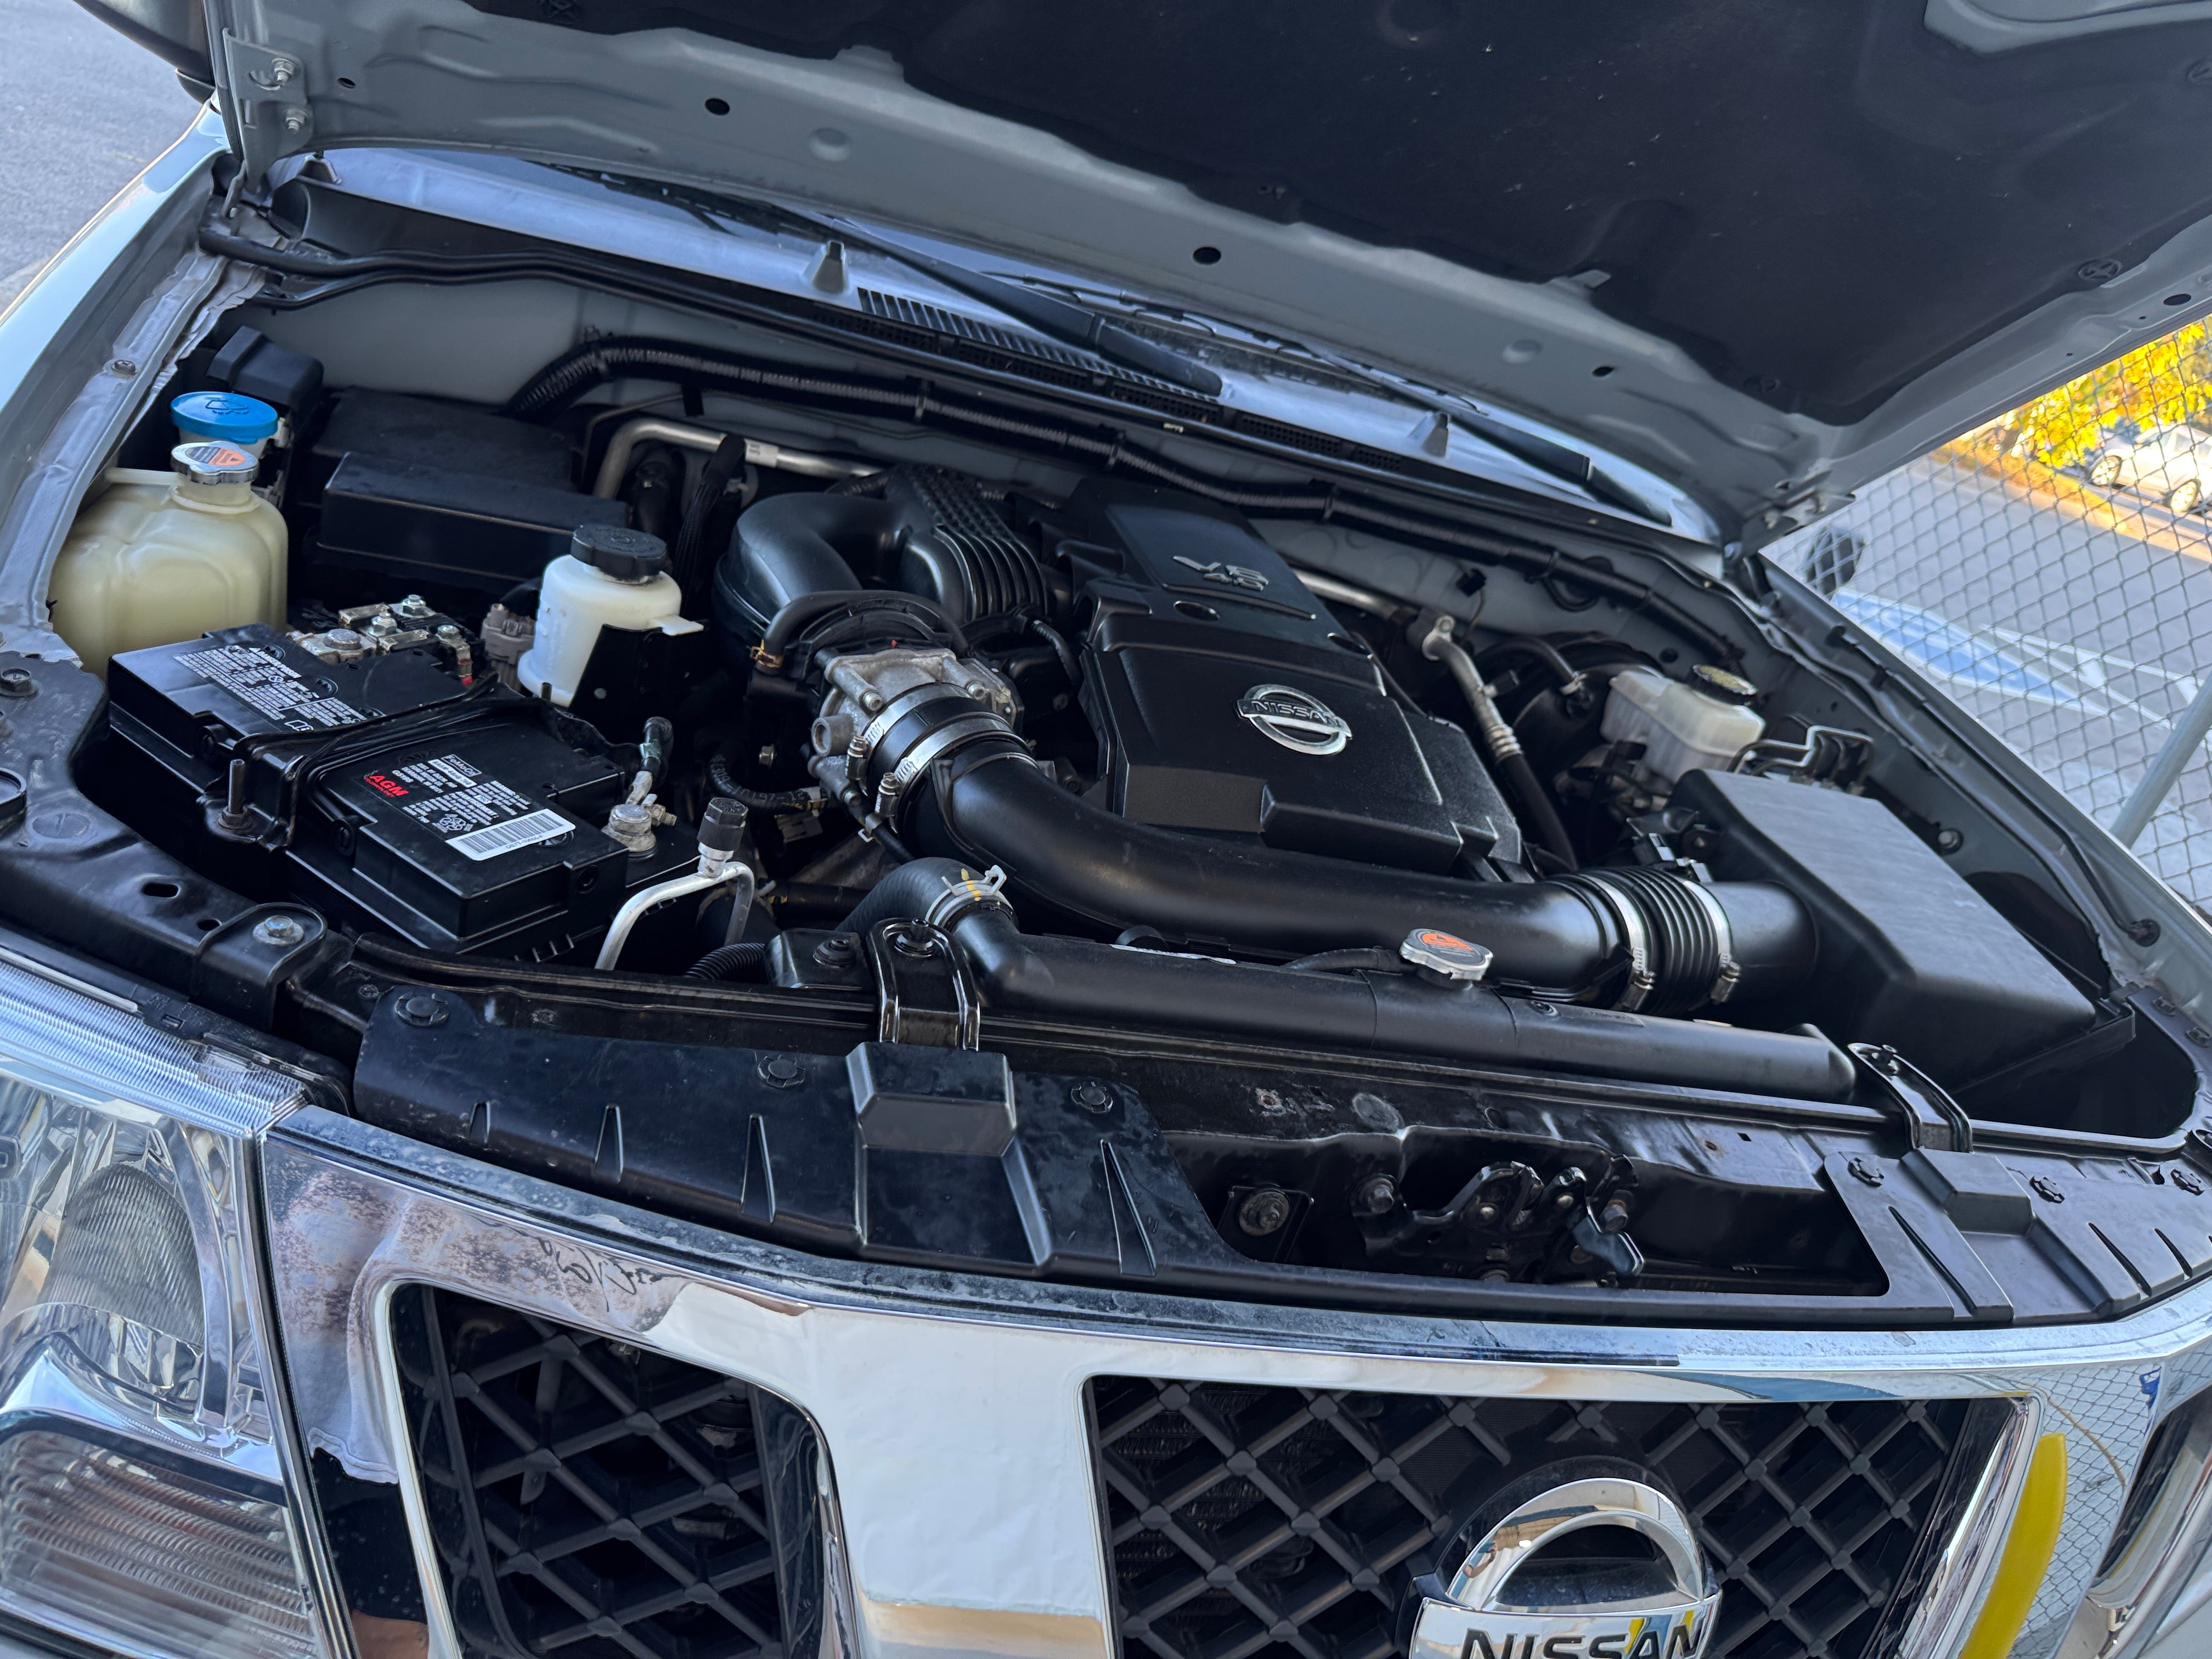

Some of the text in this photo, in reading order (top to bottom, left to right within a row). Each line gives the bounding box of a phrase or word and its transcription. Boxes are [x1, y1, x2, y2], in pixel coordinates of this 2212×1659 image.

[1173, 556, 1269, 585] V6
[1251, 701, 1341, 728] NISSAN
[369, 775, 409, 797] AGM
[1460, 1624, 1702, 1659] NISSAN
